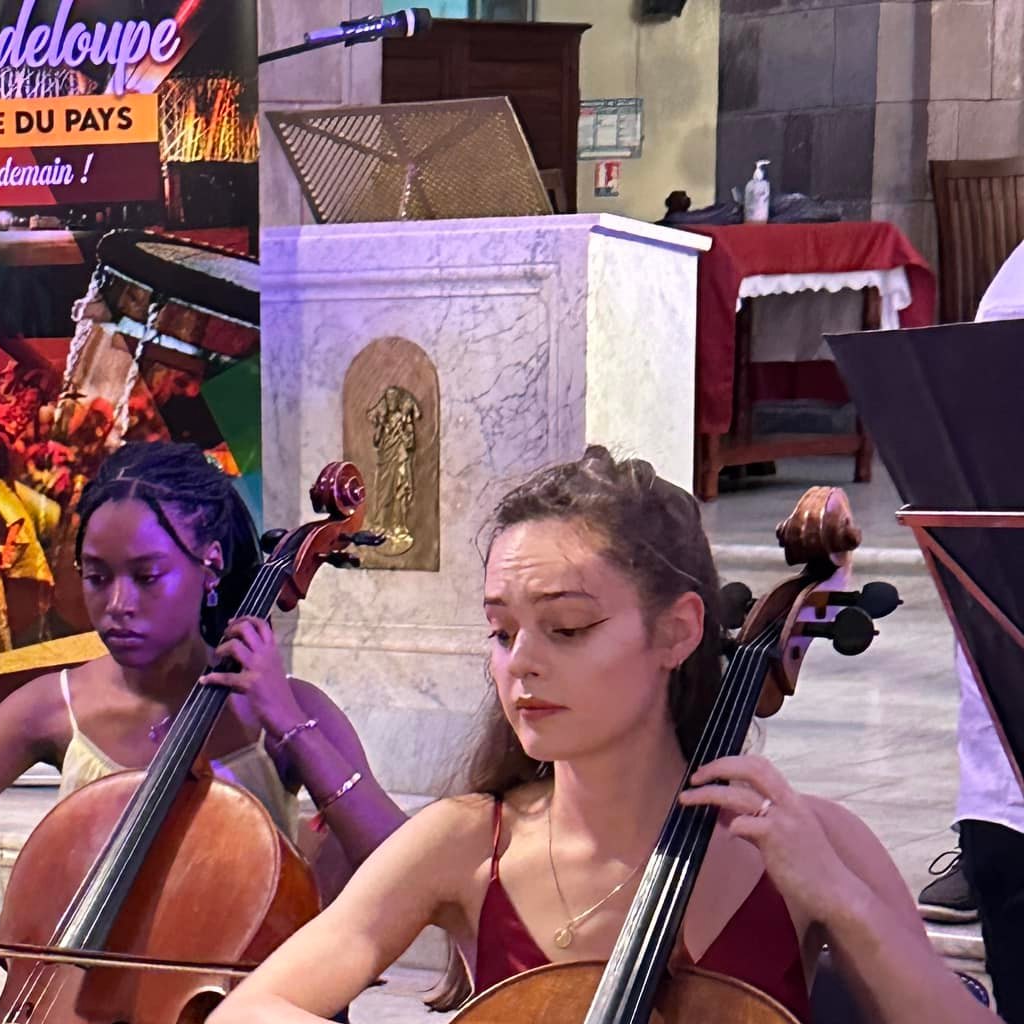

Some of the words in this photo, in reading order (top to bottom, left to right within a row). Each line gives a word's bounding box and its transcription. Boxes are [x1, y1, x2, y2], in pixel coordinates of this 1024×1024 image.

[15, 109, 55, 135] DU
[65, 106, 134, 132] PAYS
[79, 151, 95, 185] !
